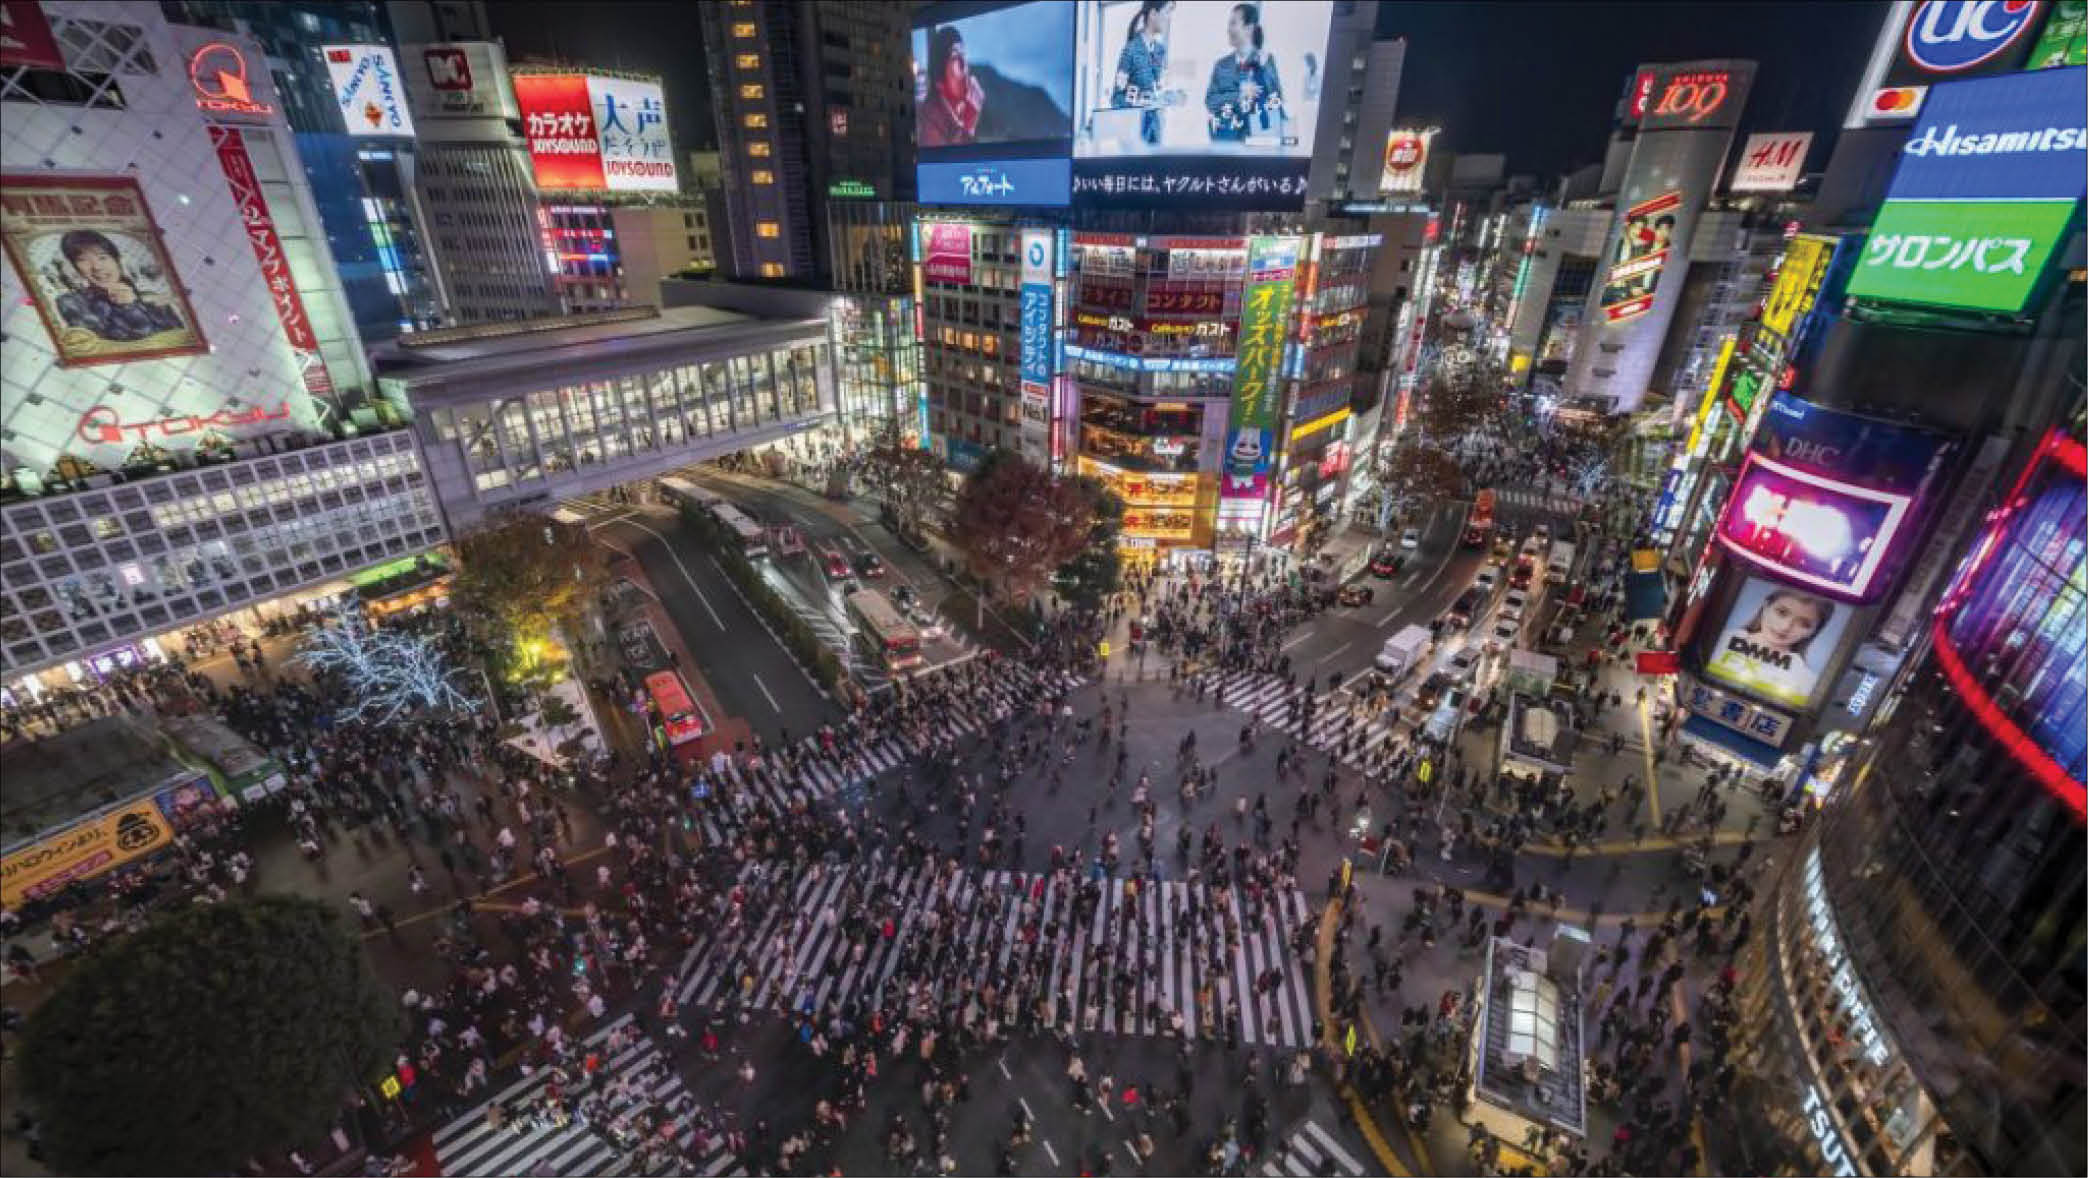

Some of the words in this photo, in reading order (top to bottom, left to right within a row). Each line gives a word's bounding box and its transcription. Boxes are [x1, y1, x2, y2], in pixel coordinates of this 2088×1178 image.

[602, 94, 662, 135] 大声
[1654, 82, 1728, 121] 109
[528, 112, 592, 136] カラオケ
[607, 160, 674, 178] JOYSOUND
[1750, 139, 1803, 169] H&M
[1866, 233, 2033, 277] サロンパス
[1196, 322, 1232, 337] ガスト
[118, 402, 290, 438] TOKYU
[1786, 436, 1841, 465] DHC
[1728, 636, 1794, 670] DMM
[1802, 1085, 1860, 1177] TSUT
